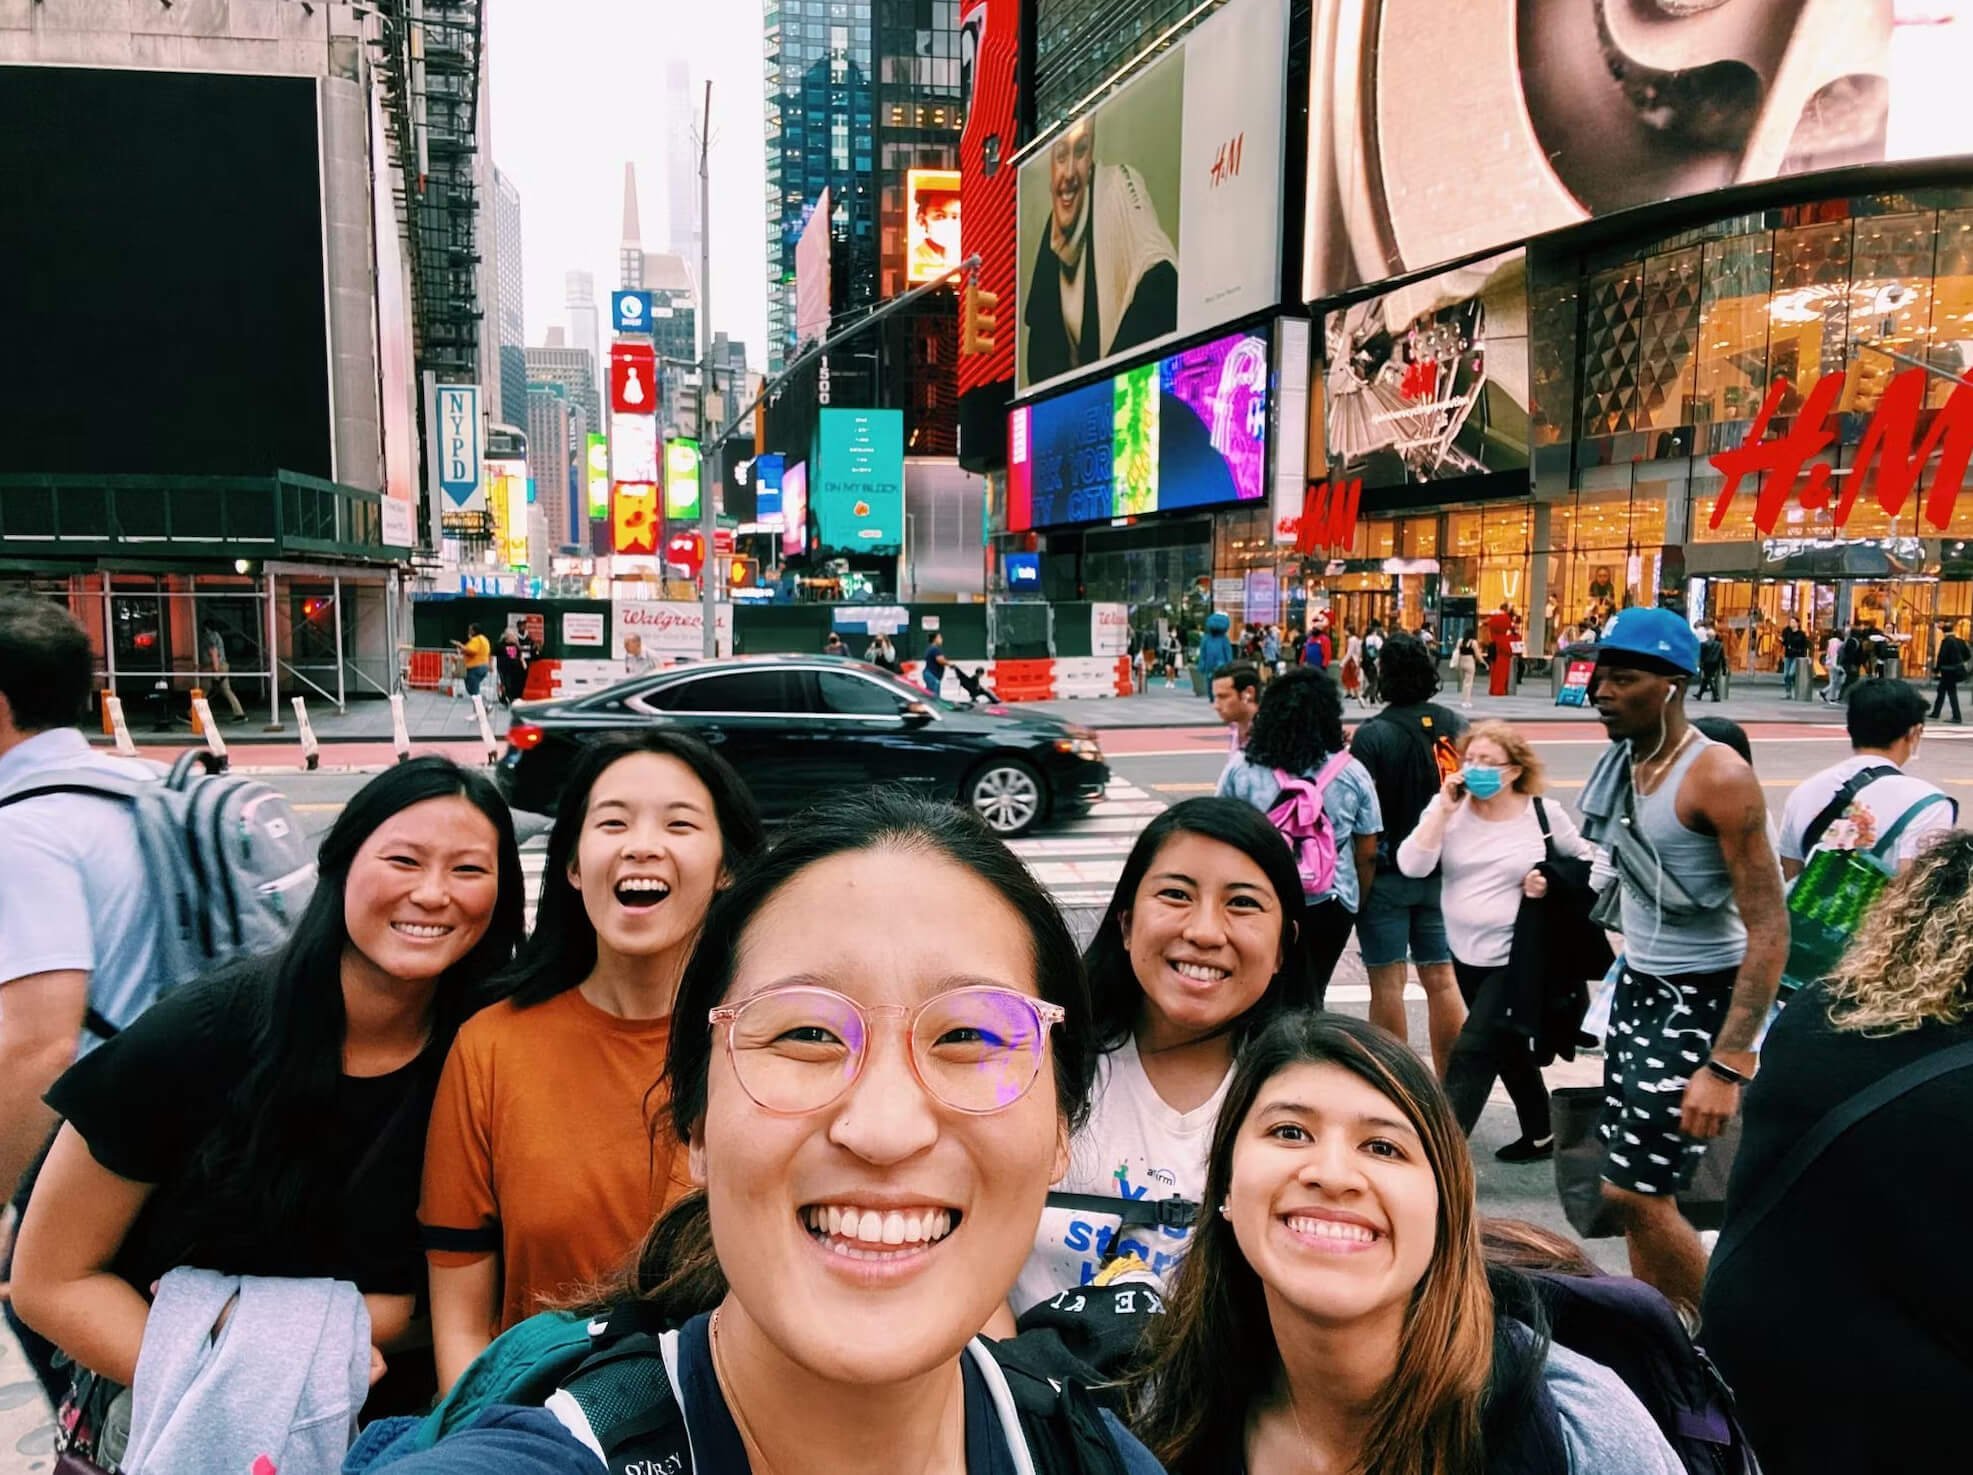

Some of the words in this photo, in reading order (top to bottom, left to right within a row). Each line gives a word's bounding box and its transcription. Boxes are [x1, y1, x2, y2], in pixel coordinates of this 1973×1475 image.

[819, 355, 830, 405] 1500
[450, 393, 466, 480] NYPD
[1709, 366, 1973, 536] H&M
[623, 609, 726, 631] Walgrees
